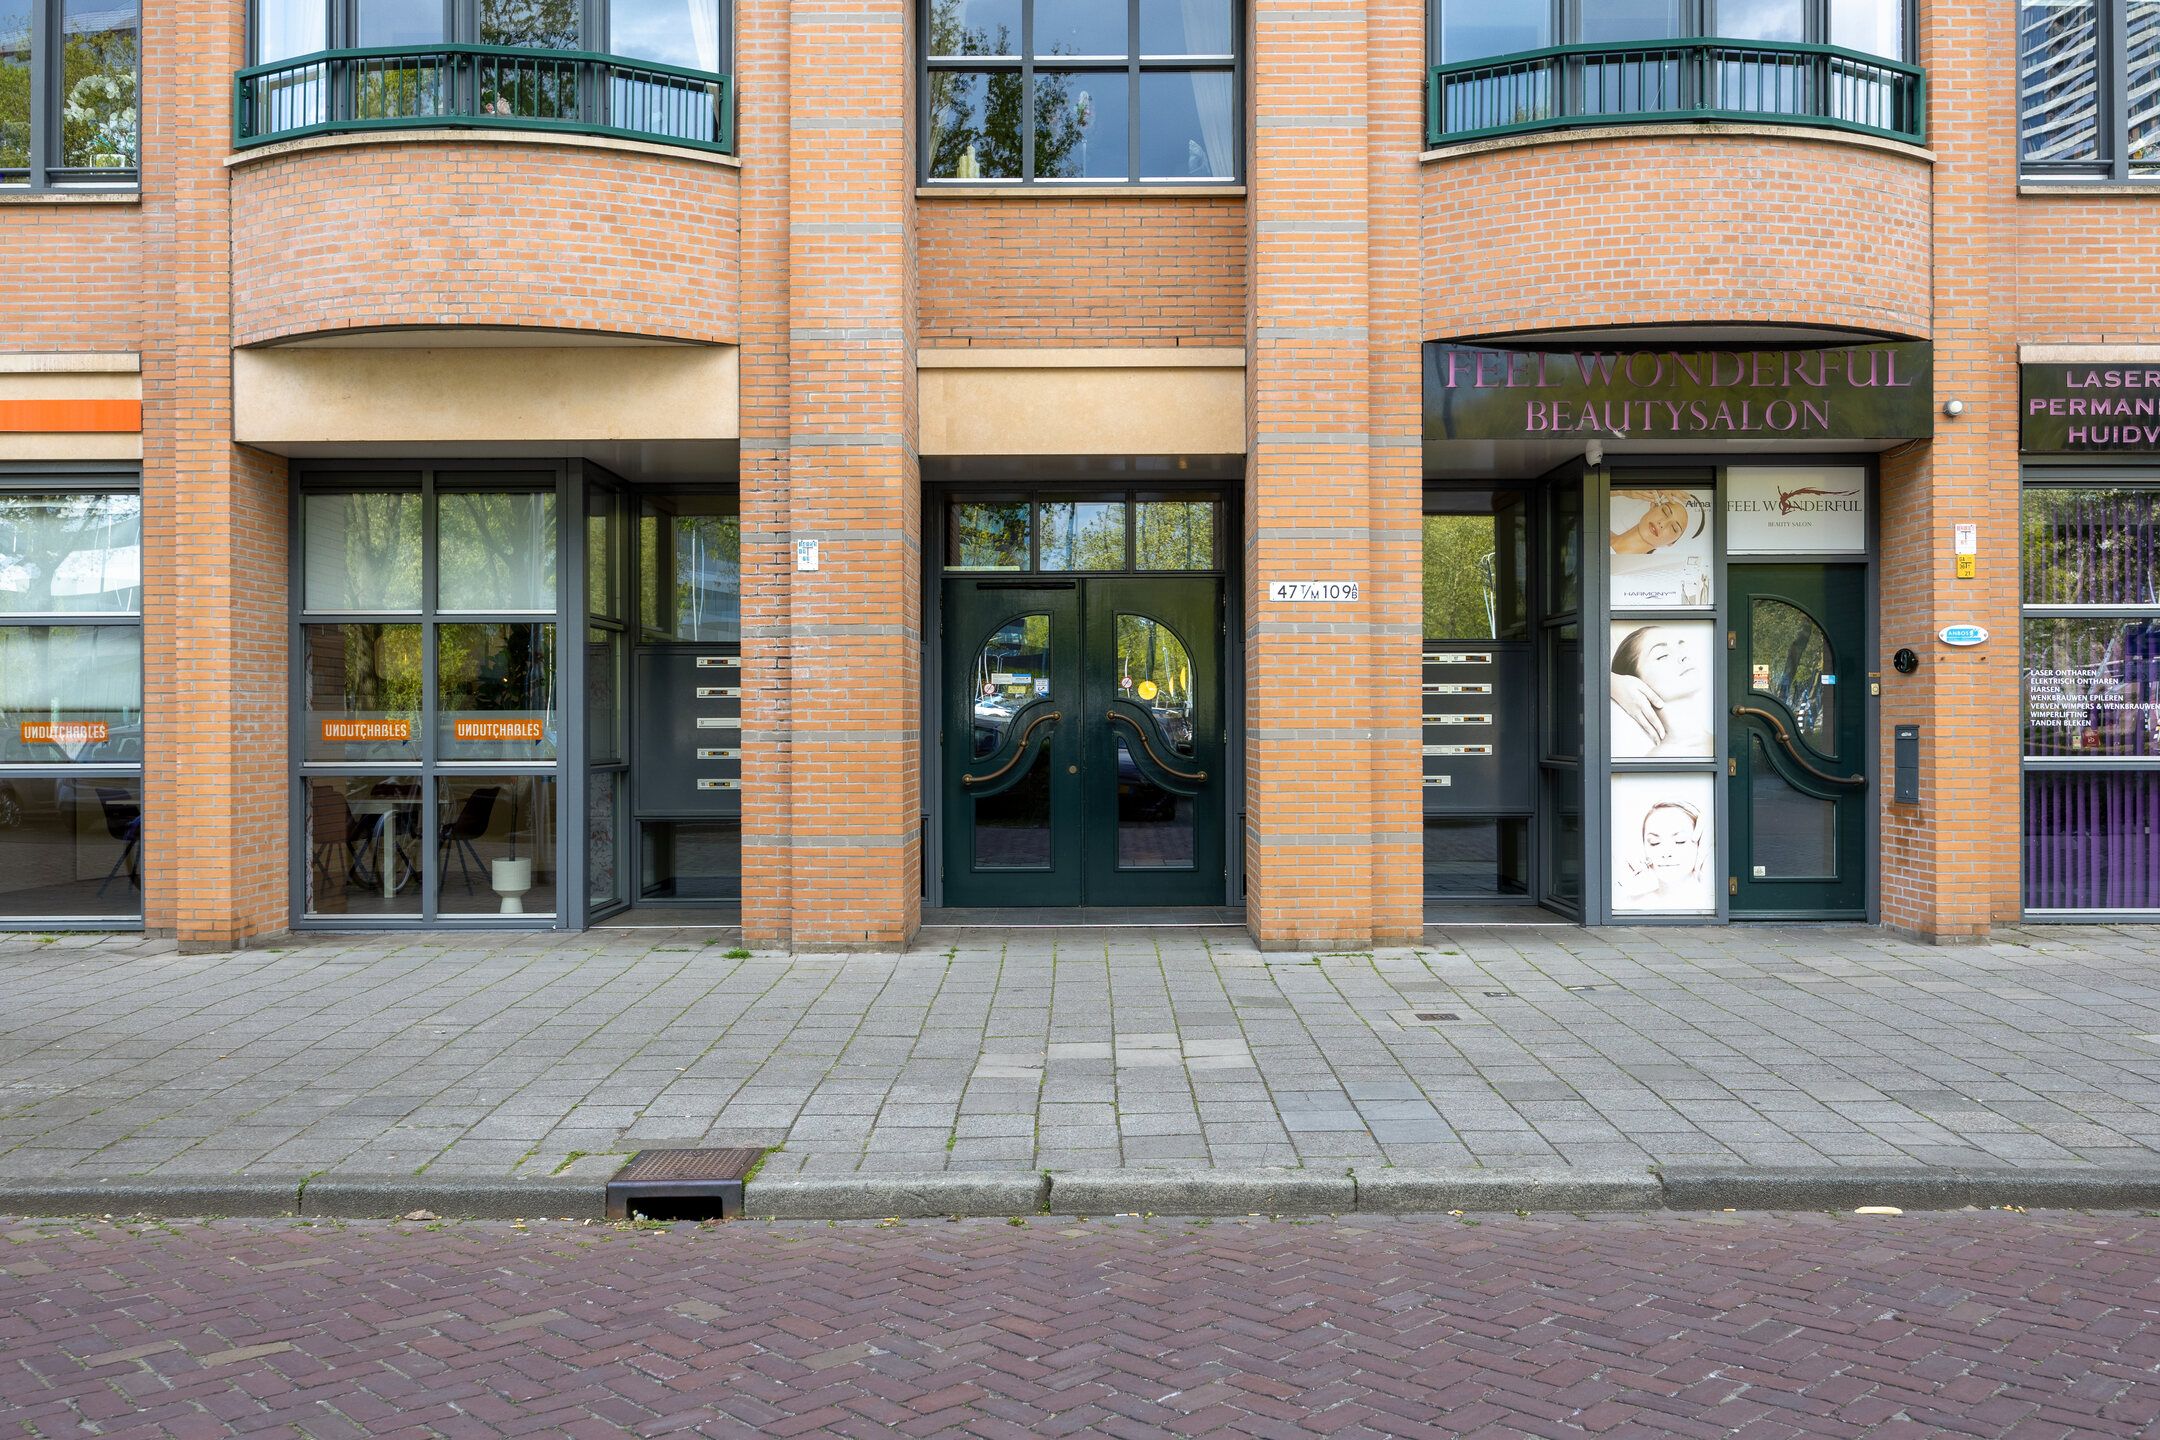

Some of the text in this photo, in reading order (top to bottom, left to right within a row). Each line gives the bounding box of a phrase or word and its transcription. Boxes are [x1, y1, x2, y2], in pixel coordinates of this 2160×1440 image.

[1444, 350, 1913, 388] FEEL WONDERFUL
[2066, 370, 2160, 388] LASER
[1525, 400, 1831, 432] BEAUTYSALON
[2029, 398, 2160, 416] PERMAN
[2068, 426, 2160, 443] HUIDV
[1727, 500, 1760, 512] FEEL
[1277, 585, 1297, 599] 47
